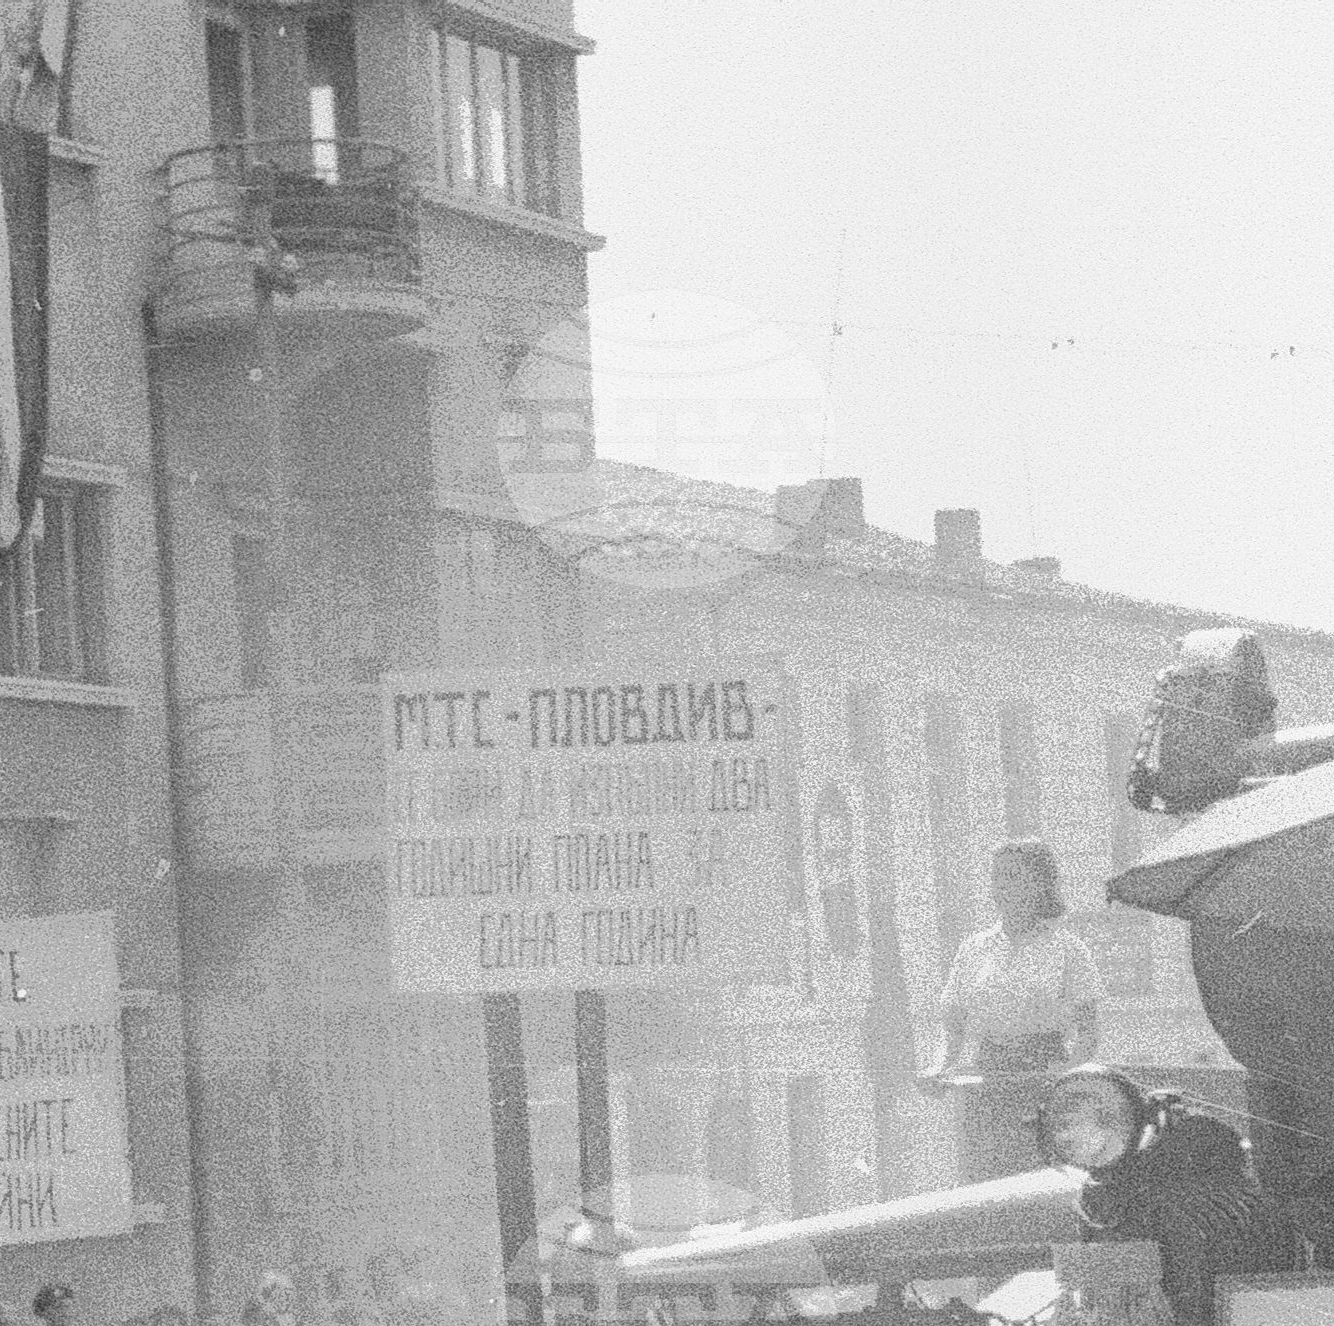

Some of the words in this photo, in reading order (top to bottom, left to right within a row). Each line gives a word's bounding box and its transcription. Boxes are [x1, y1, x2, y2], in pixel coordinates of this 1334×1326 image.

[708, 757, 772, 814] ДВА
[396, 836, 533, 898] ГОДИШНИ
[552, 831, 655, 893] ПЛАНА
[478, 910, 559, 969] ЕДНА
[581, 906, 702, 967] ГОДИНА
